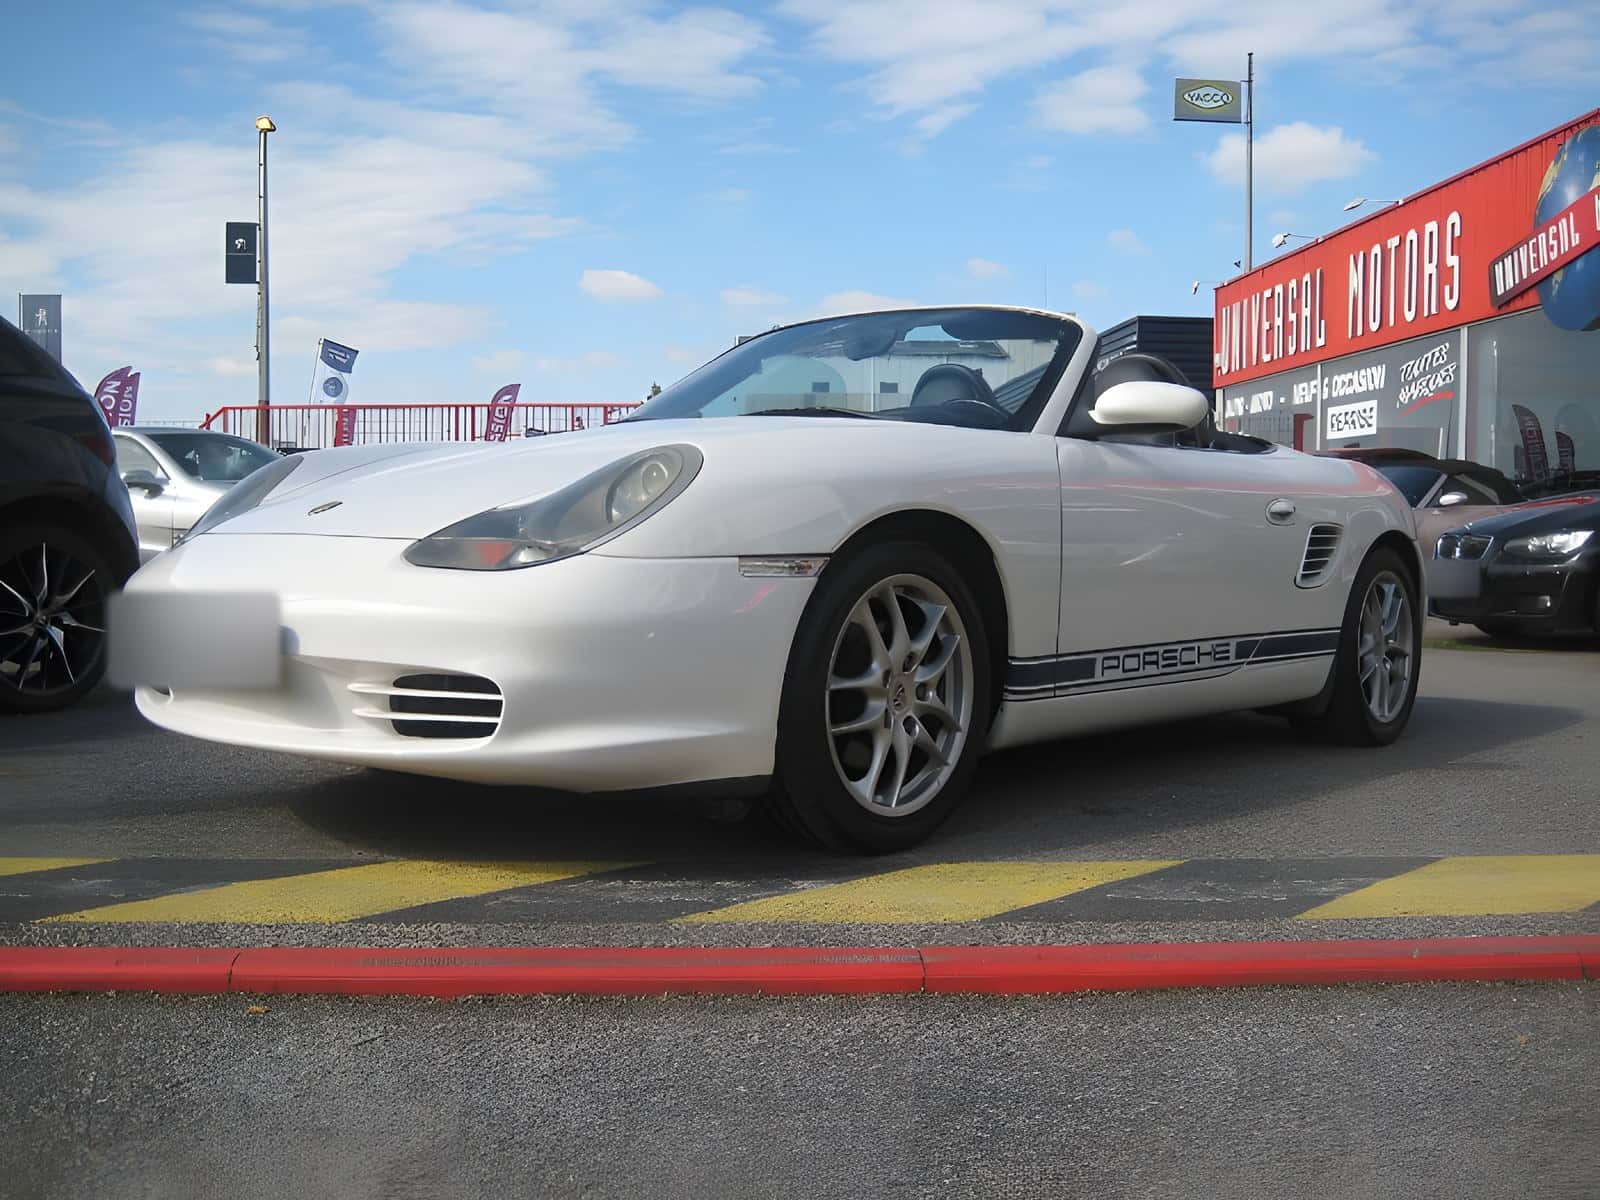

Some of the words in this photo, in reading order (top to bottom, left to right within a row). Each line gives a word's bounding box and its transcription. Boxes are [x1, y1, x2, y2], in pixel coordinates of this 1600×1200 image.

[1187, 93, 1230, 104] YACCO
[1494, 212, 1580, 296] UNIVERSAL
[1216, 267, 1326, 377] UNIVERSAL
[1348, 210, 1463, 340] MOTORS
[1102, 643, 1231, 677] PORSCHE
